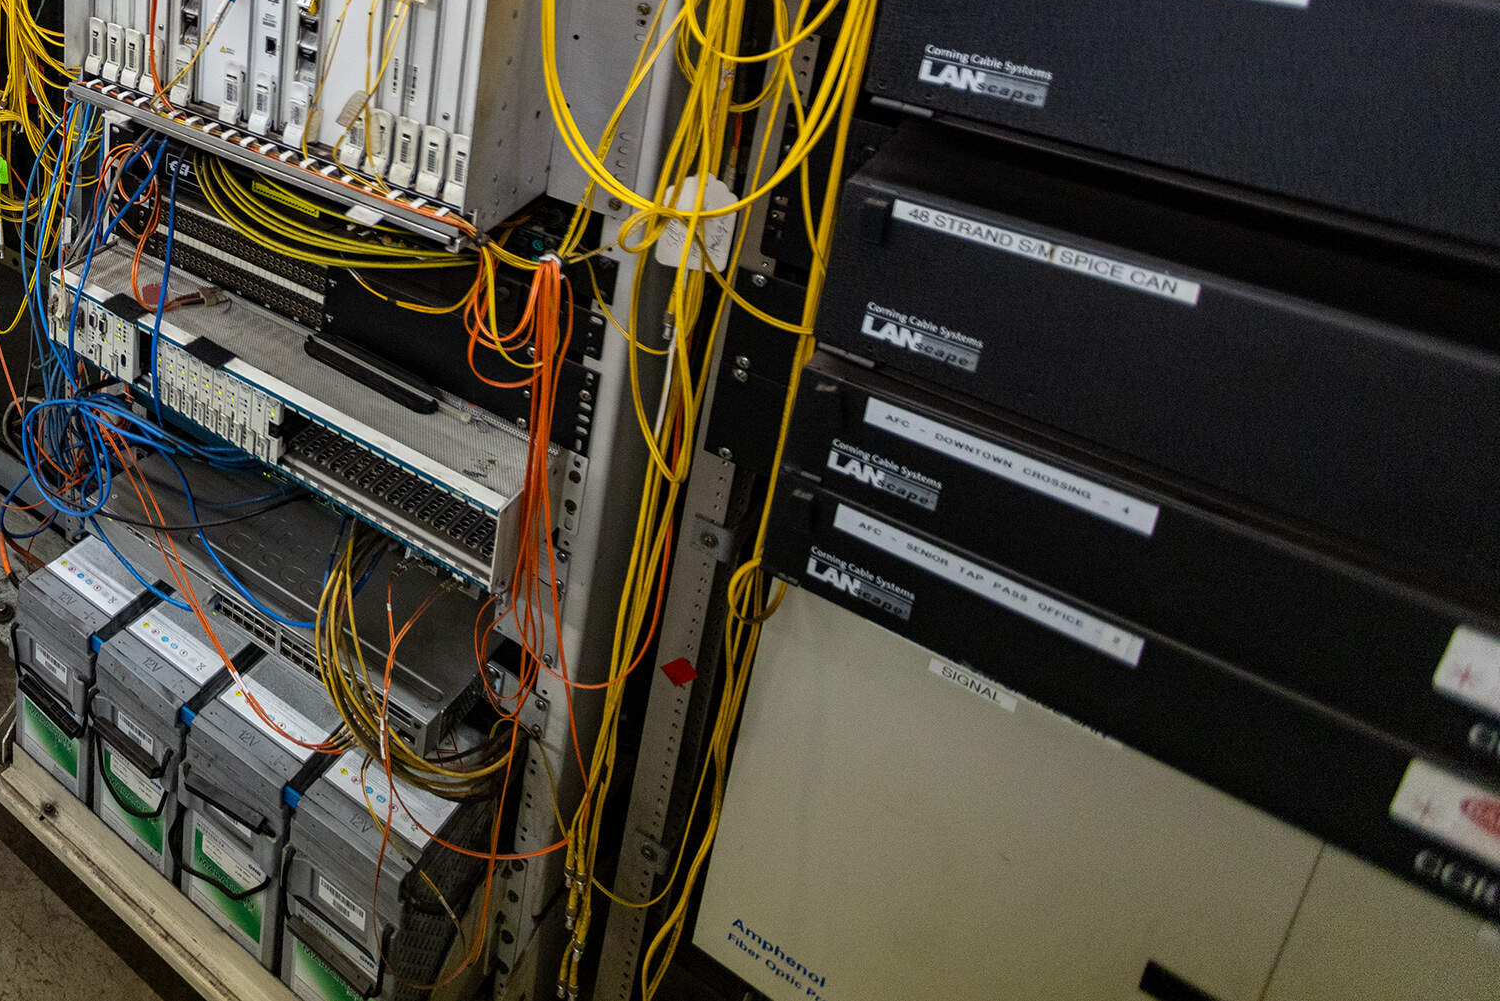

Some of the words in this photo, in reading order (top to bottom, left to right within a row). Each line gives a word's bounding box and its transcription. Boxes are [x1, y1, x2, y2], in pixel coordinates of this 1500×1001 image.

[918, 58, 1037, 104] LANscape
[925, 43, 971, 65] Corning
[971, 51, 1004, 71] Cable
[1004, 60, 1053, 81] Systems
[907, 207, 931, 223] 48
[934, 213, 1014, 248] STRAND
[1018, 238, 1055, 260] S/M
[1059, 249, 1125, 280] SPICE
[1129, 269, 1179, 295] CAN
[860, 314, 969, 367] LANscape
[866, 300, 909, 325] Corning
[908, 313, 939, 335] Cable
[939, 326, 984, 350] Systems
[826, 450, 932, 509] LANscape
[832, 437, 872, 467] Corning
[871, 452, 900, 476] Cable
[900, 465, 943, 490] Systems
[885, 412, 911, 430] AFC
[934, 432, 1014, 470] DOWNTOWN
[1022, 466, 1093, 501] CROSSING
[57, 590, 77, 606] 12V
[810, 545, 848, 573] Corning
[847, 560, 876, 584] Cable
[875, 575, 916, 601] Systems
[857, 520, 882, 537] AFC
[905, 541, 950, 568] SENIOR
[958, 565, 985, 582] TAP
[992, 580, 1029, 603] PASS
[1037, 601, 1085, 629] OFFICE
[142, 656, 164, 673] 12V
[940, 664, 1001, 702] SIGNAL
[238, 729, 260, 748] 12V
[350, 814, 375, 834] 12V
[727, 932, 762, 961] Fiber
[765, 958, 803, 990] Optic
[732, 918, 827, 988] Amphenol
